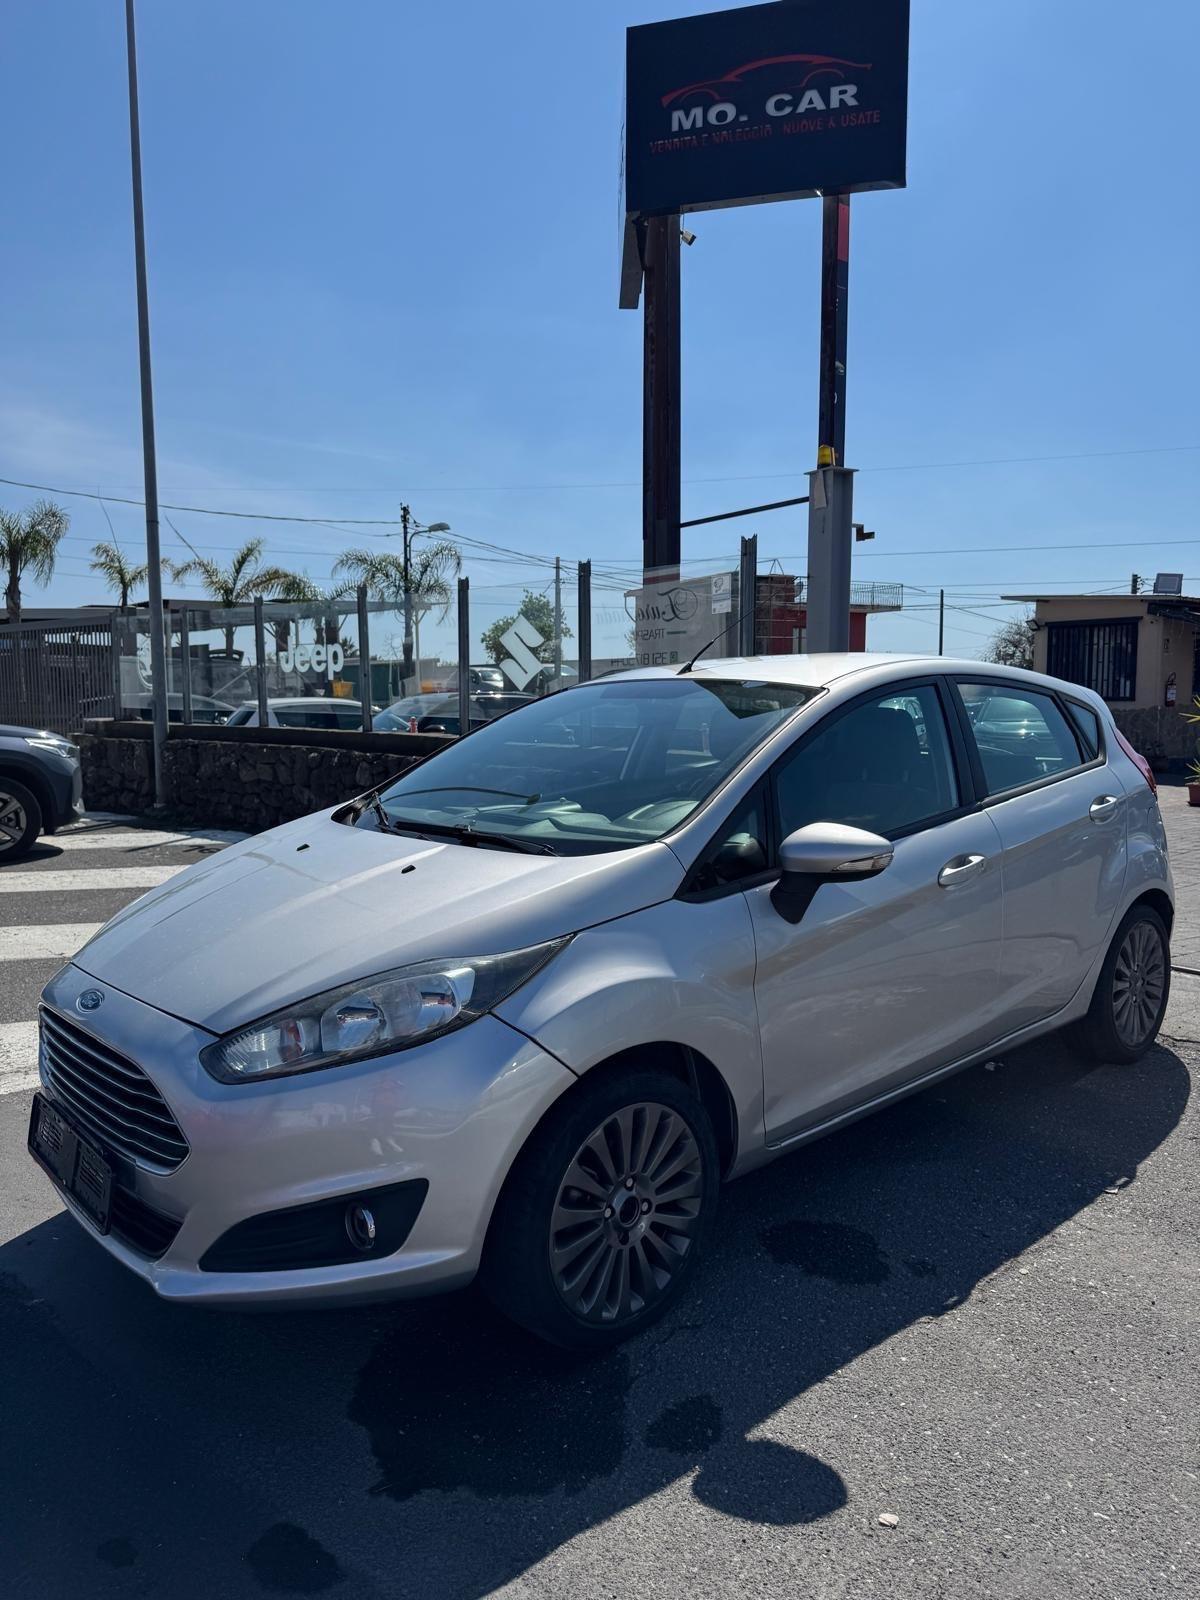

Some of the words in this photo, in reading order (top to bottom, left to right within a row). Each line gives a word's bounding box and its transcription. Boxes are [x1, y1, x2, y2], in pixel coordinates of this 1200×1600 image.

[671, 102, 748, 132] MO.
[765, 84, 859, 117] CAR
[783, 118, 823, 136] NUOVE
[841, 110, 881, 127] USATE
[278, 635, 344, 680] Jeep
